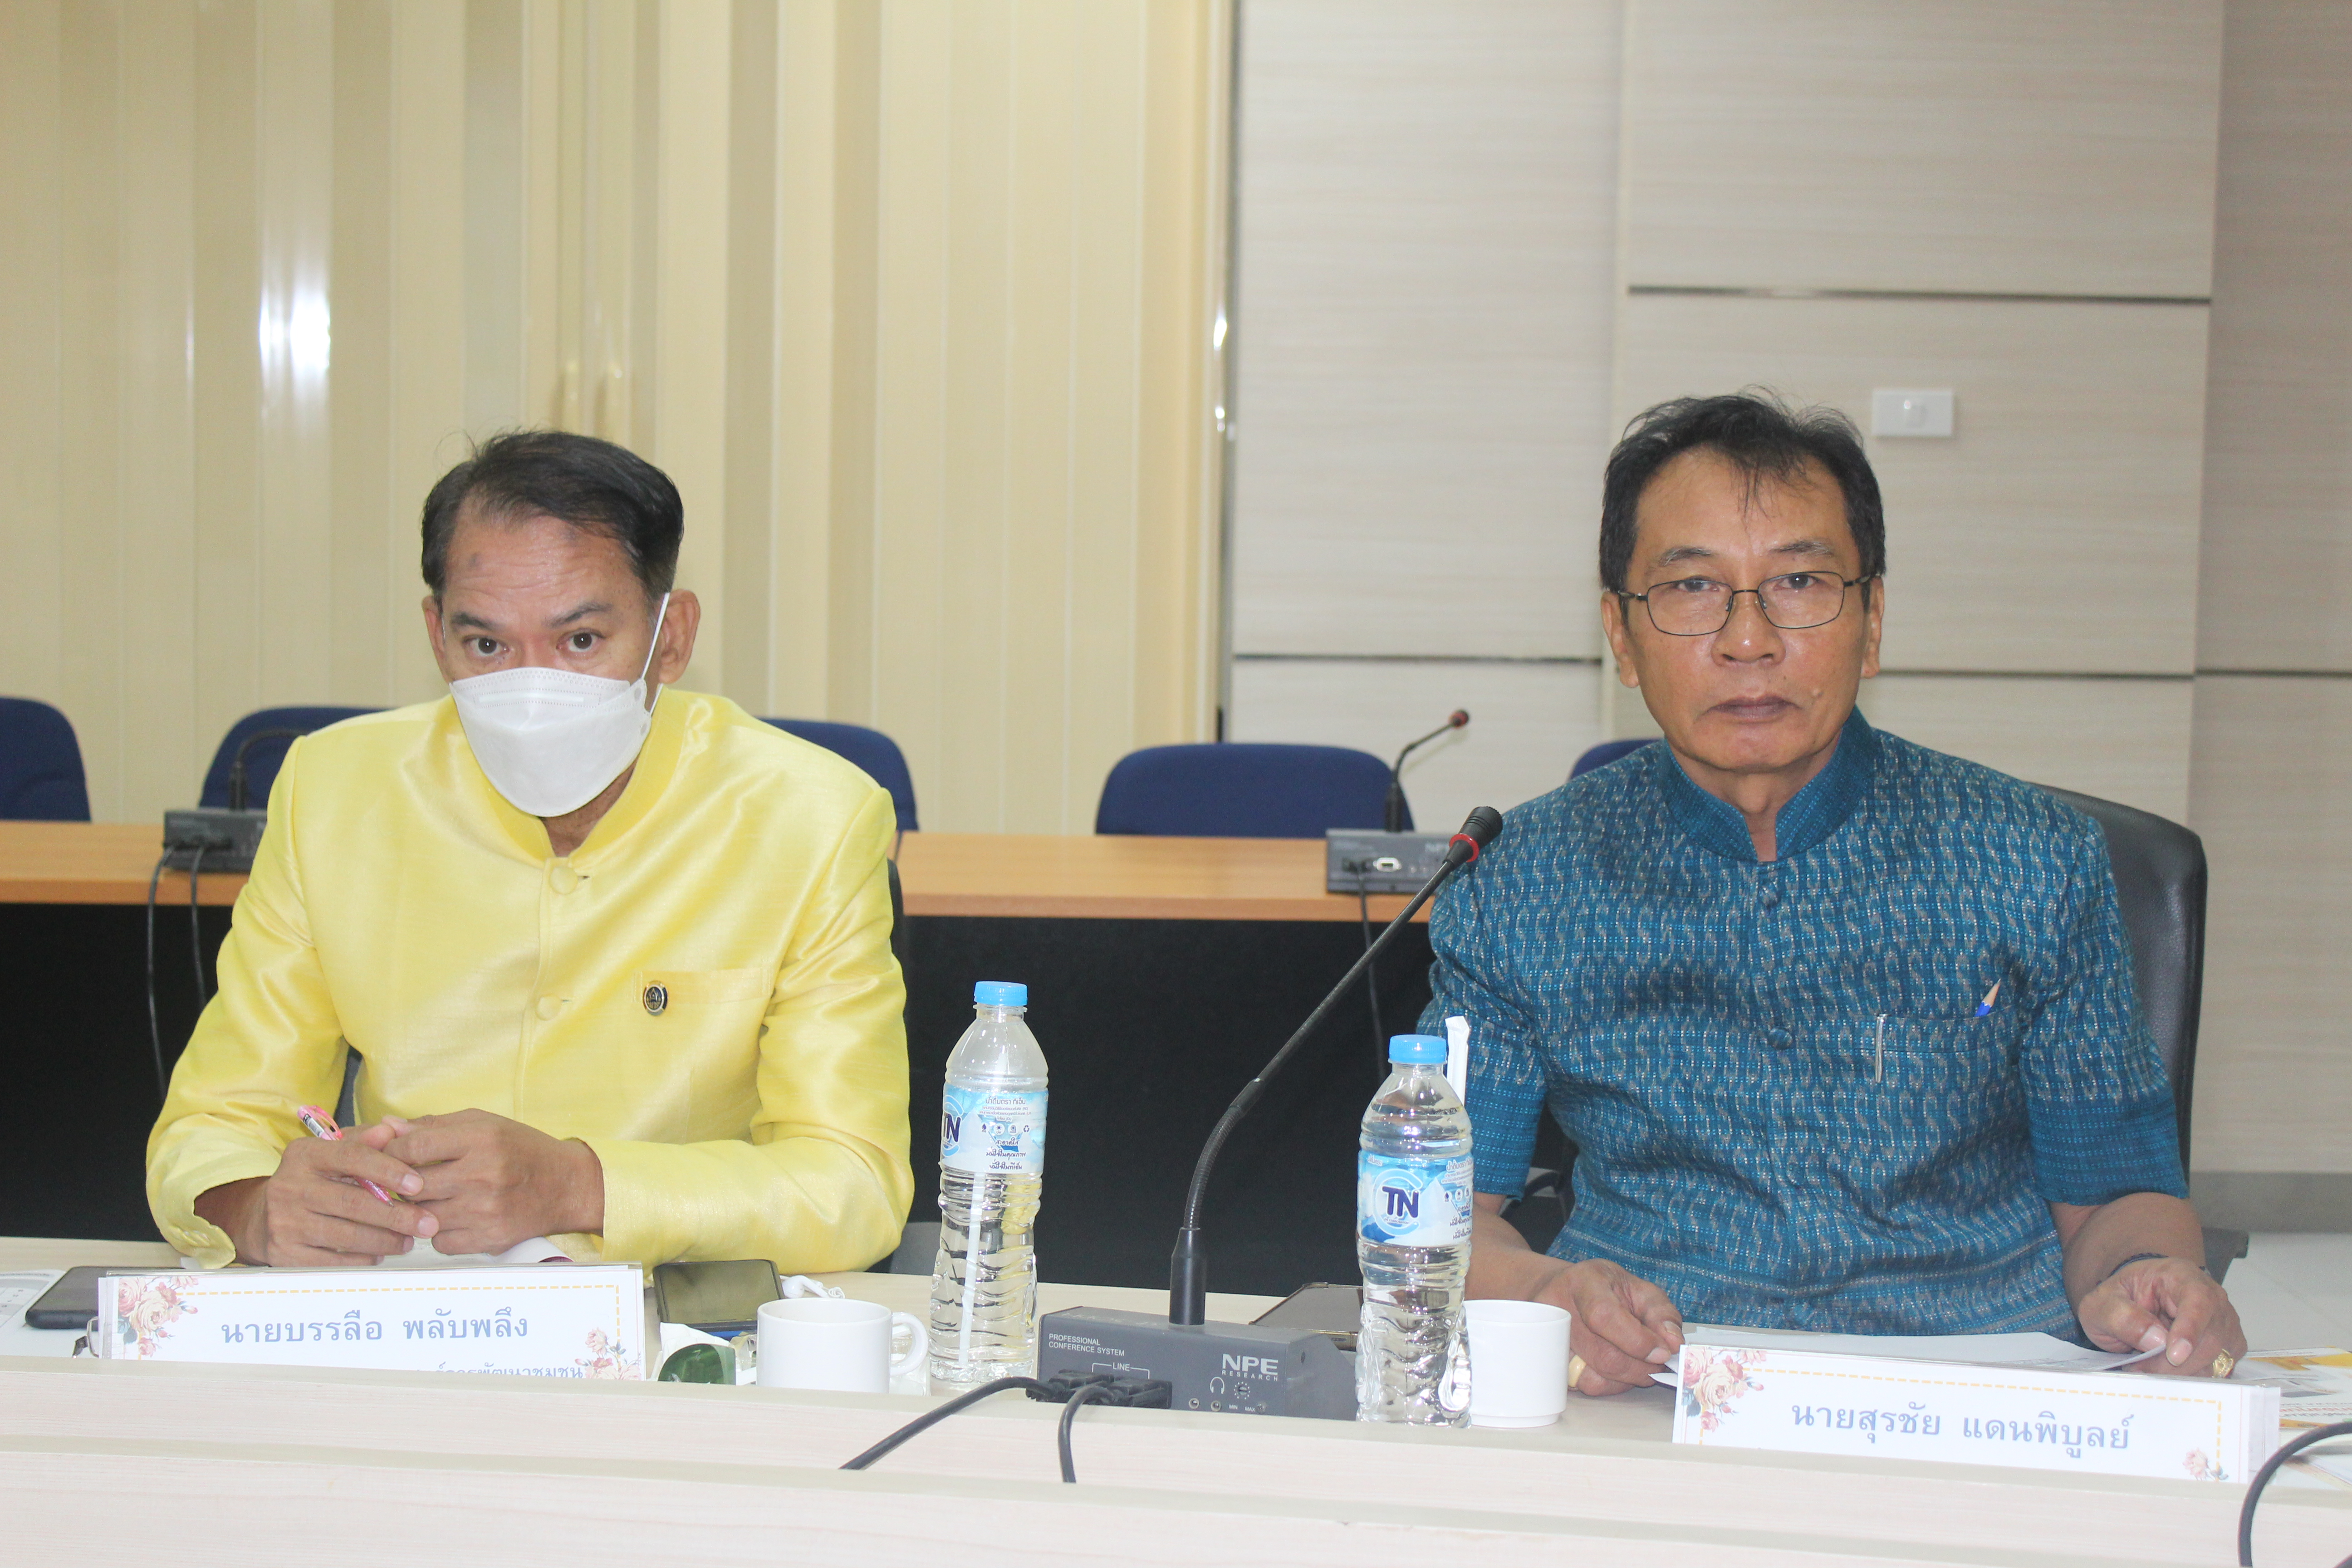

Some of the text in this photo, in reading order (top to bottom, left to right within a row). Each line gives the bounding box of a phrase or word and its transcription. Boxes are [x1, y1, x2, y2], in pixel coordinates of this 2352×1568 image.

[1382, 1186, 1419, 1218] TN
[221, 1306, 528, 1343] นายบรรลือ พลับพลึง
[1049, 1333, 1100, 1346] PROFESSIONAL
[1049, 1341, 1125, 1356] CONFERENCE SYSTEM
[1112, 1362, 1130, 1371] LINE
[1222, 1353, 1279, 1376] NPE
[1222, 1370, 1278, 1382] RESEARCH
[1792, 1401, 2134, 1458] นายสุรชัย แดนพิบูลย์
